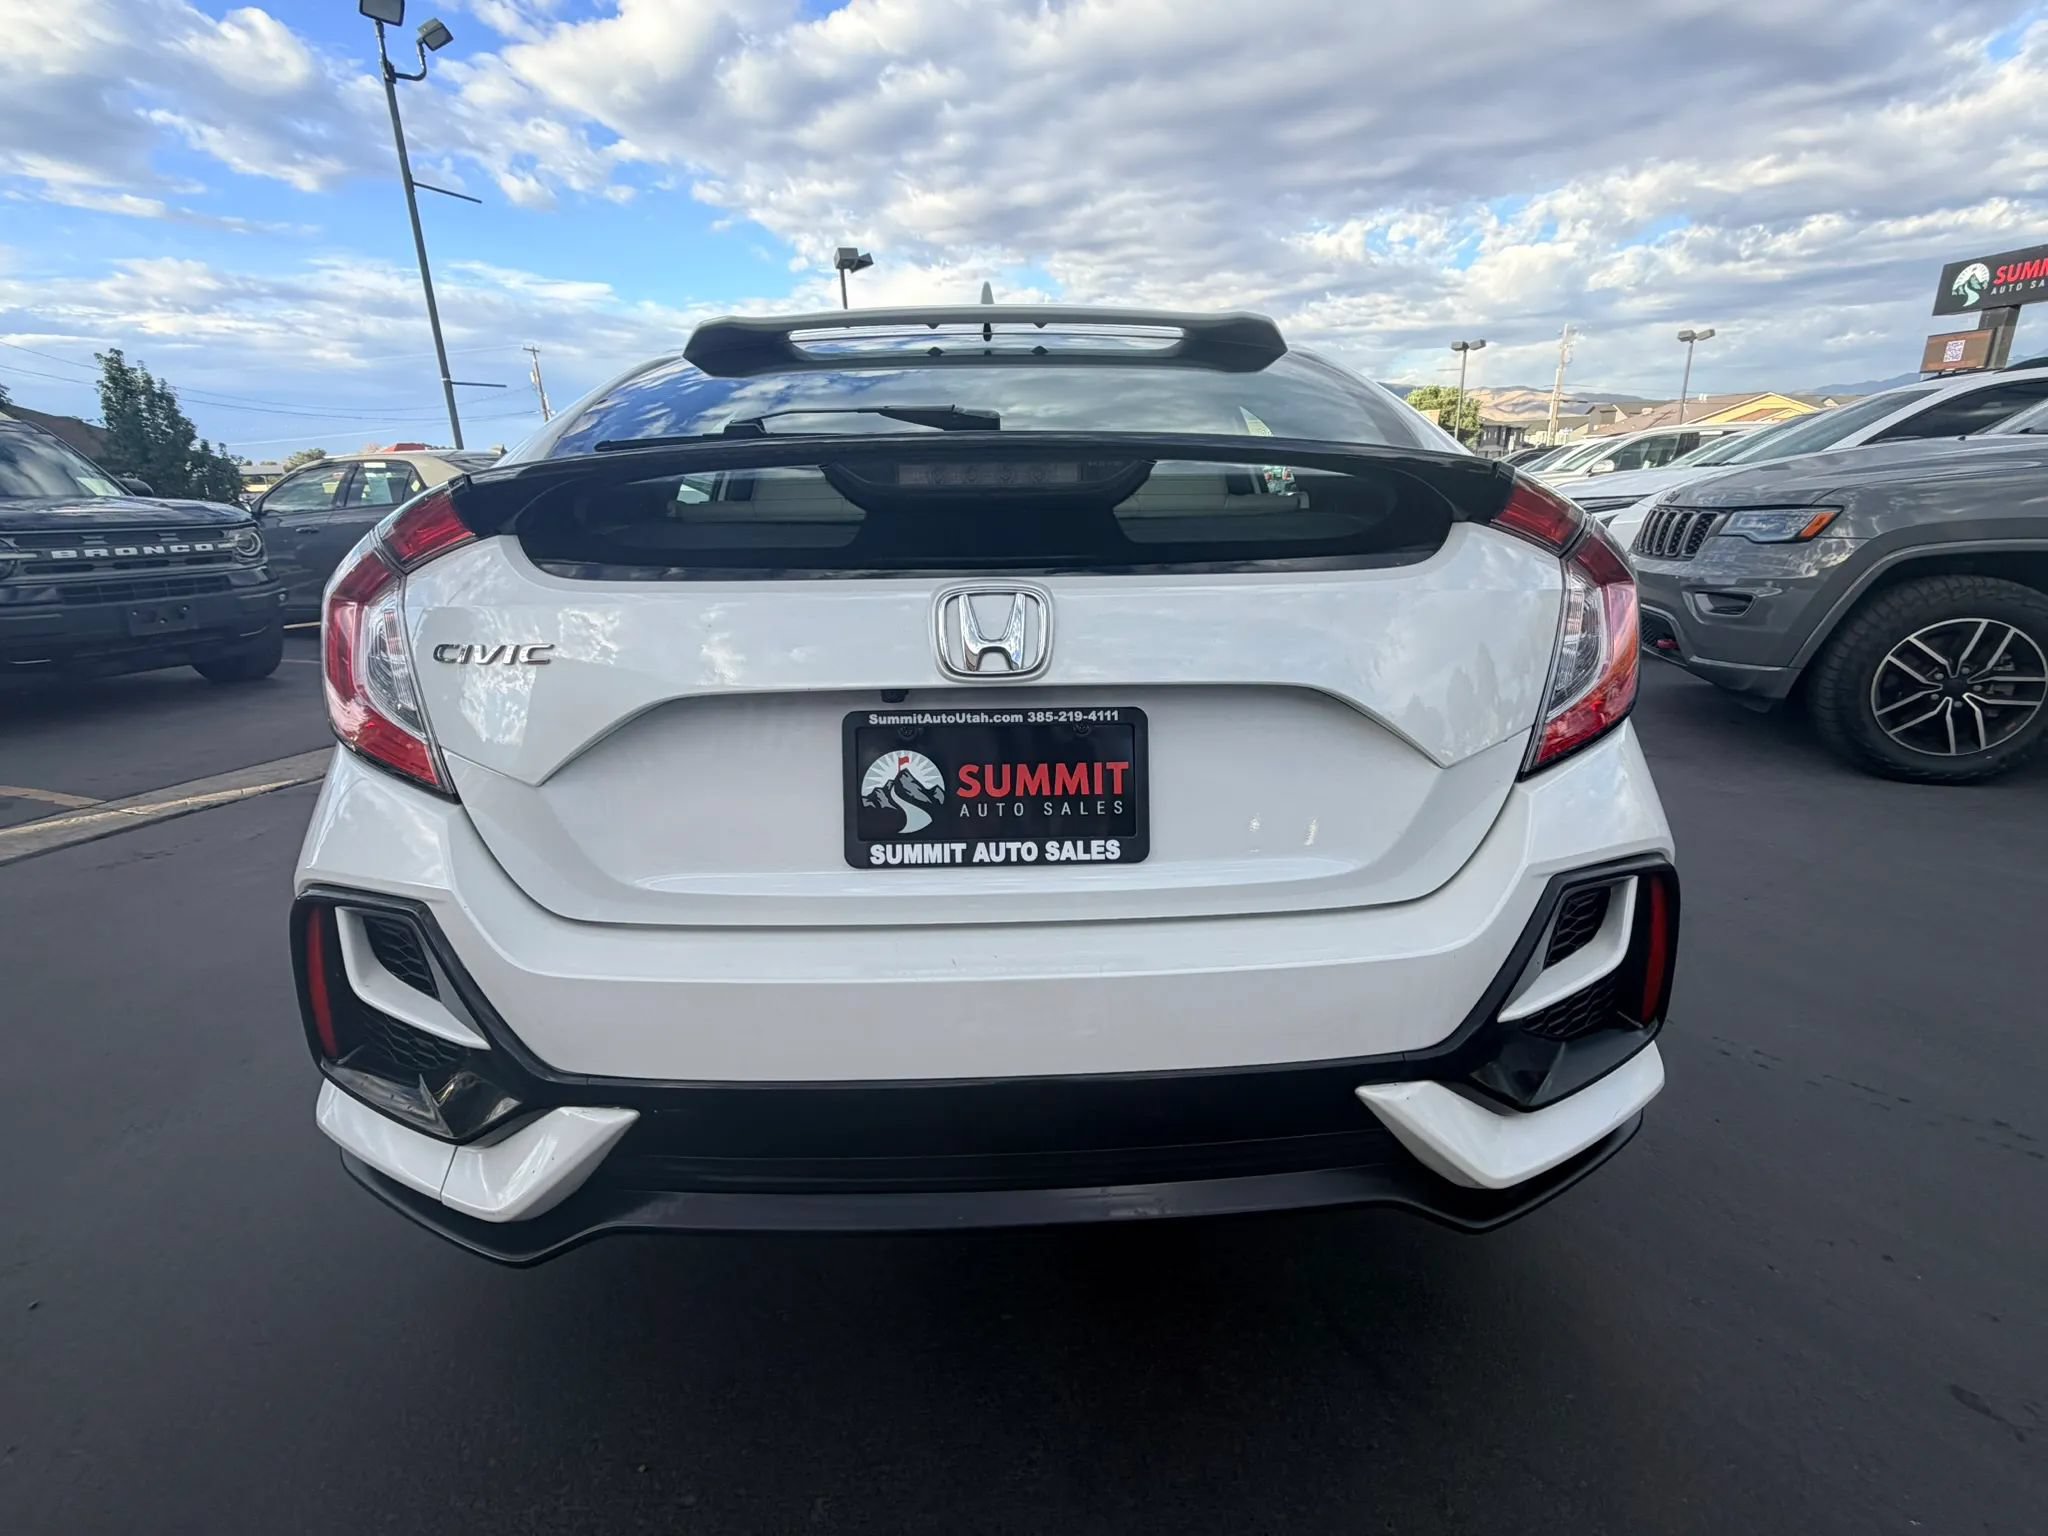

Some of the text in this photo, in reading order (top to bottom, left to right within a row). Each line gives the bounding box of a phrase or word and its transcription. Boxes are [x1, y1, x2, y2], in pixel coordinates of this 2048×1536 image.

[1990, 282, 2023, 295] AUTO
[51, 543, 214, 559] BRONCO
[433, 643, 555, 665] CIVIC
[868, 710, 1119, 725] SummitAutoUtah.com 385-219-4111
[956, 761, 1129, 799] SUMMIT
[959, 800, 1123, 817] AUTO SALES
[869, 840, 1121, 865] SUMMIT AUTO SALES
